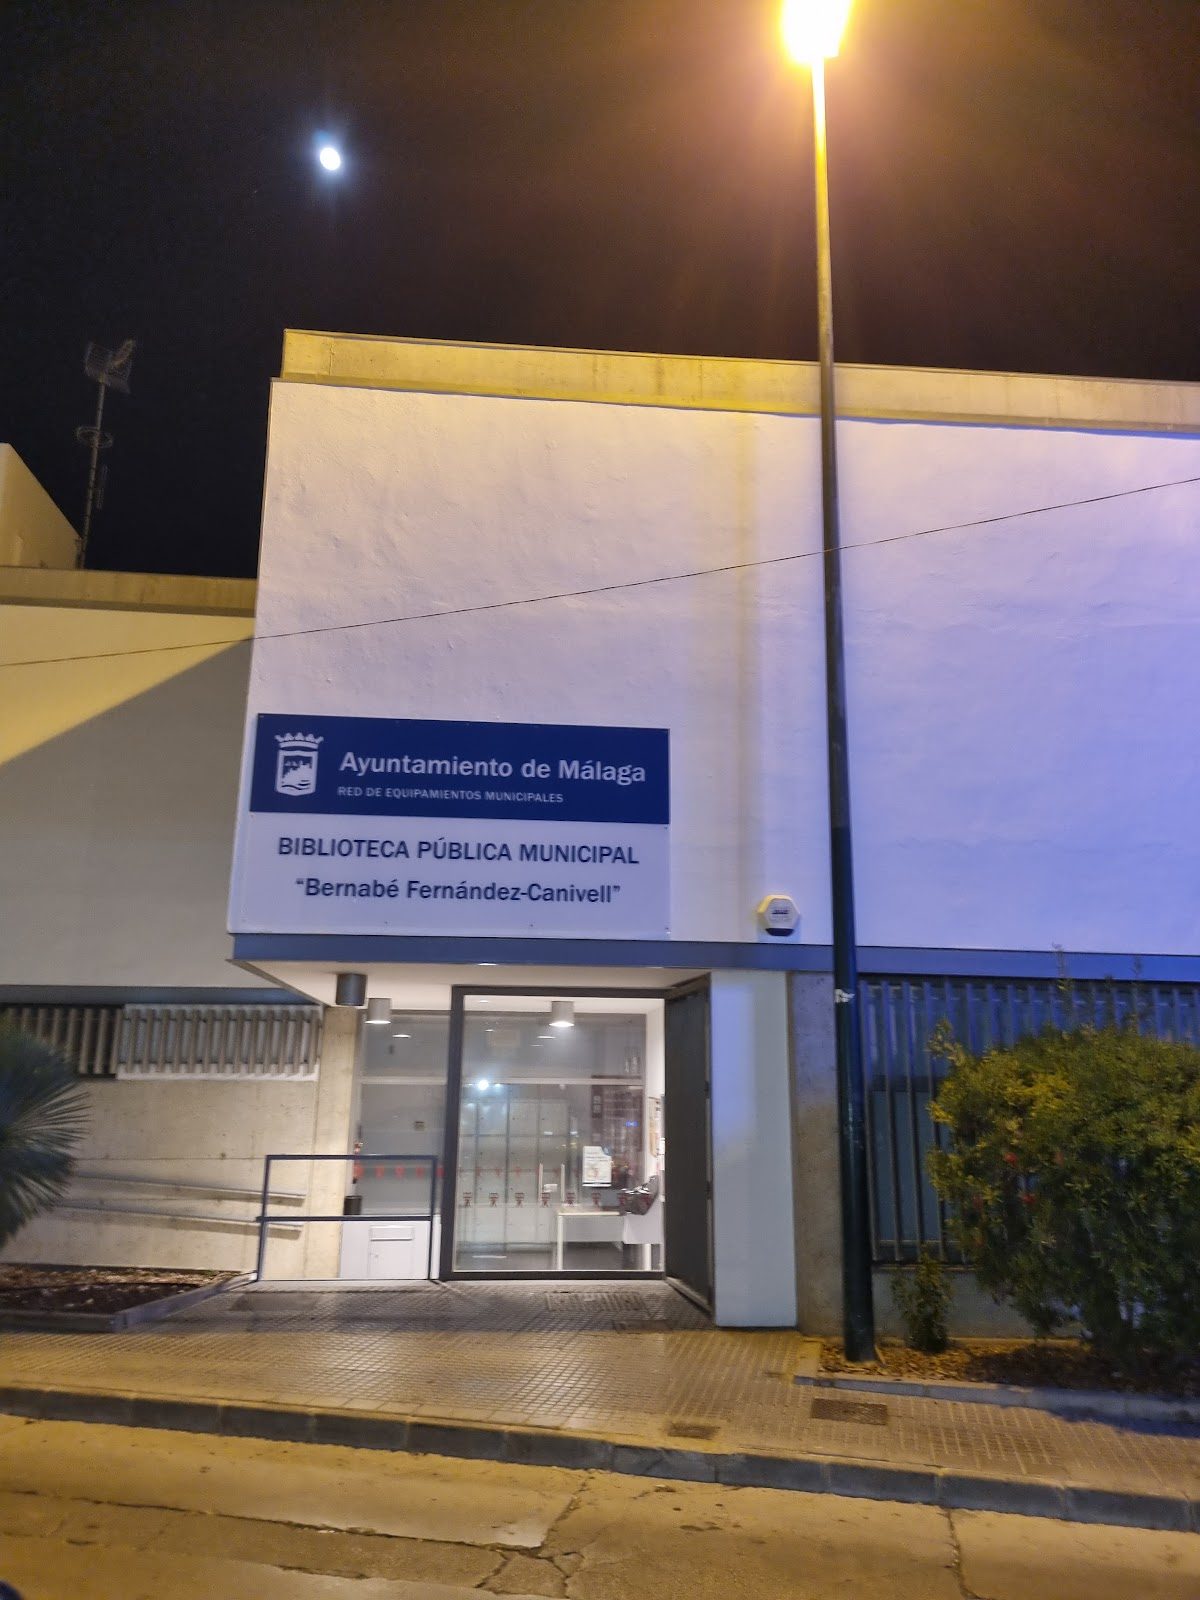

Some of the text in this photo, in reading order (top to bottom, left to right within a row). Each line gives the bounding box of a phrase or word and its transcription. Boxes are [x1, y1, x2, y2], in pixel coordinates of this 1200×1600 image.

[338, 751, 647, 786] Ayuntamiento de Málaga
[337, 786, 564, 804] RED DE EQUIPAMIENTOS MUNICIPALES
[277, 837, 640, 865] BIBLIOTECA PÚBLICA MUNICIPAL
[295, 878, 621, 904] “Bernabé Fernández-Canivell”
